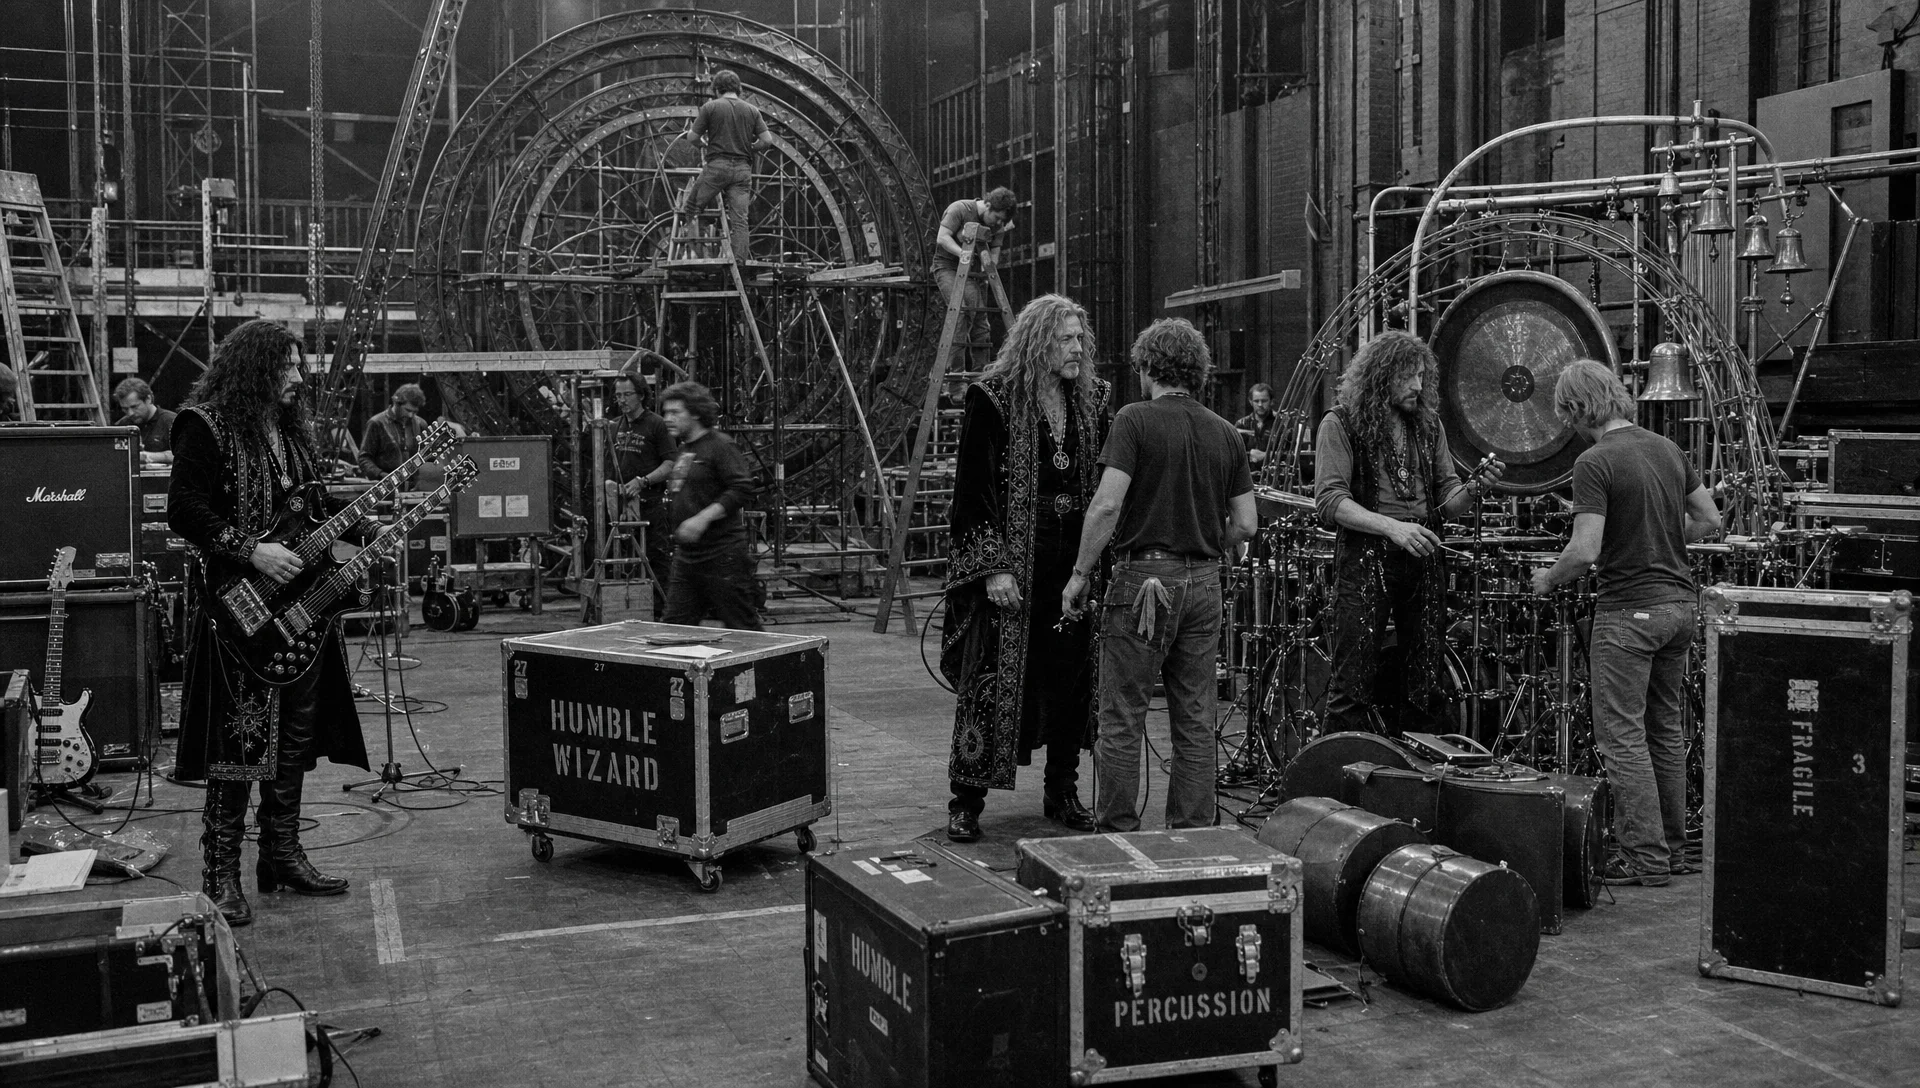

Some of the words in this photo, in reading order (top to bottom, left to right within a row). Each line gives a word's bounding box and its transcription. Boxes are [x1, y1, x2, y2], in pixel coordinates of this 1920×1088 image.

[26, 487, 86, 502] Marshall
[514, 660, 528, 677] 27
[594, 662, 605, 672] 27
[551, 699, 657, 745] HUMBLE
[552, 743, 659, 791] WIZARD
[1791, 721, 1814, 817] FRAGILE
[1851, 753, 1866, 774] 3
[851, 932, 912, 1014] HUMBLE
[1114, 987, 1271, 1028] PERCUSSION
